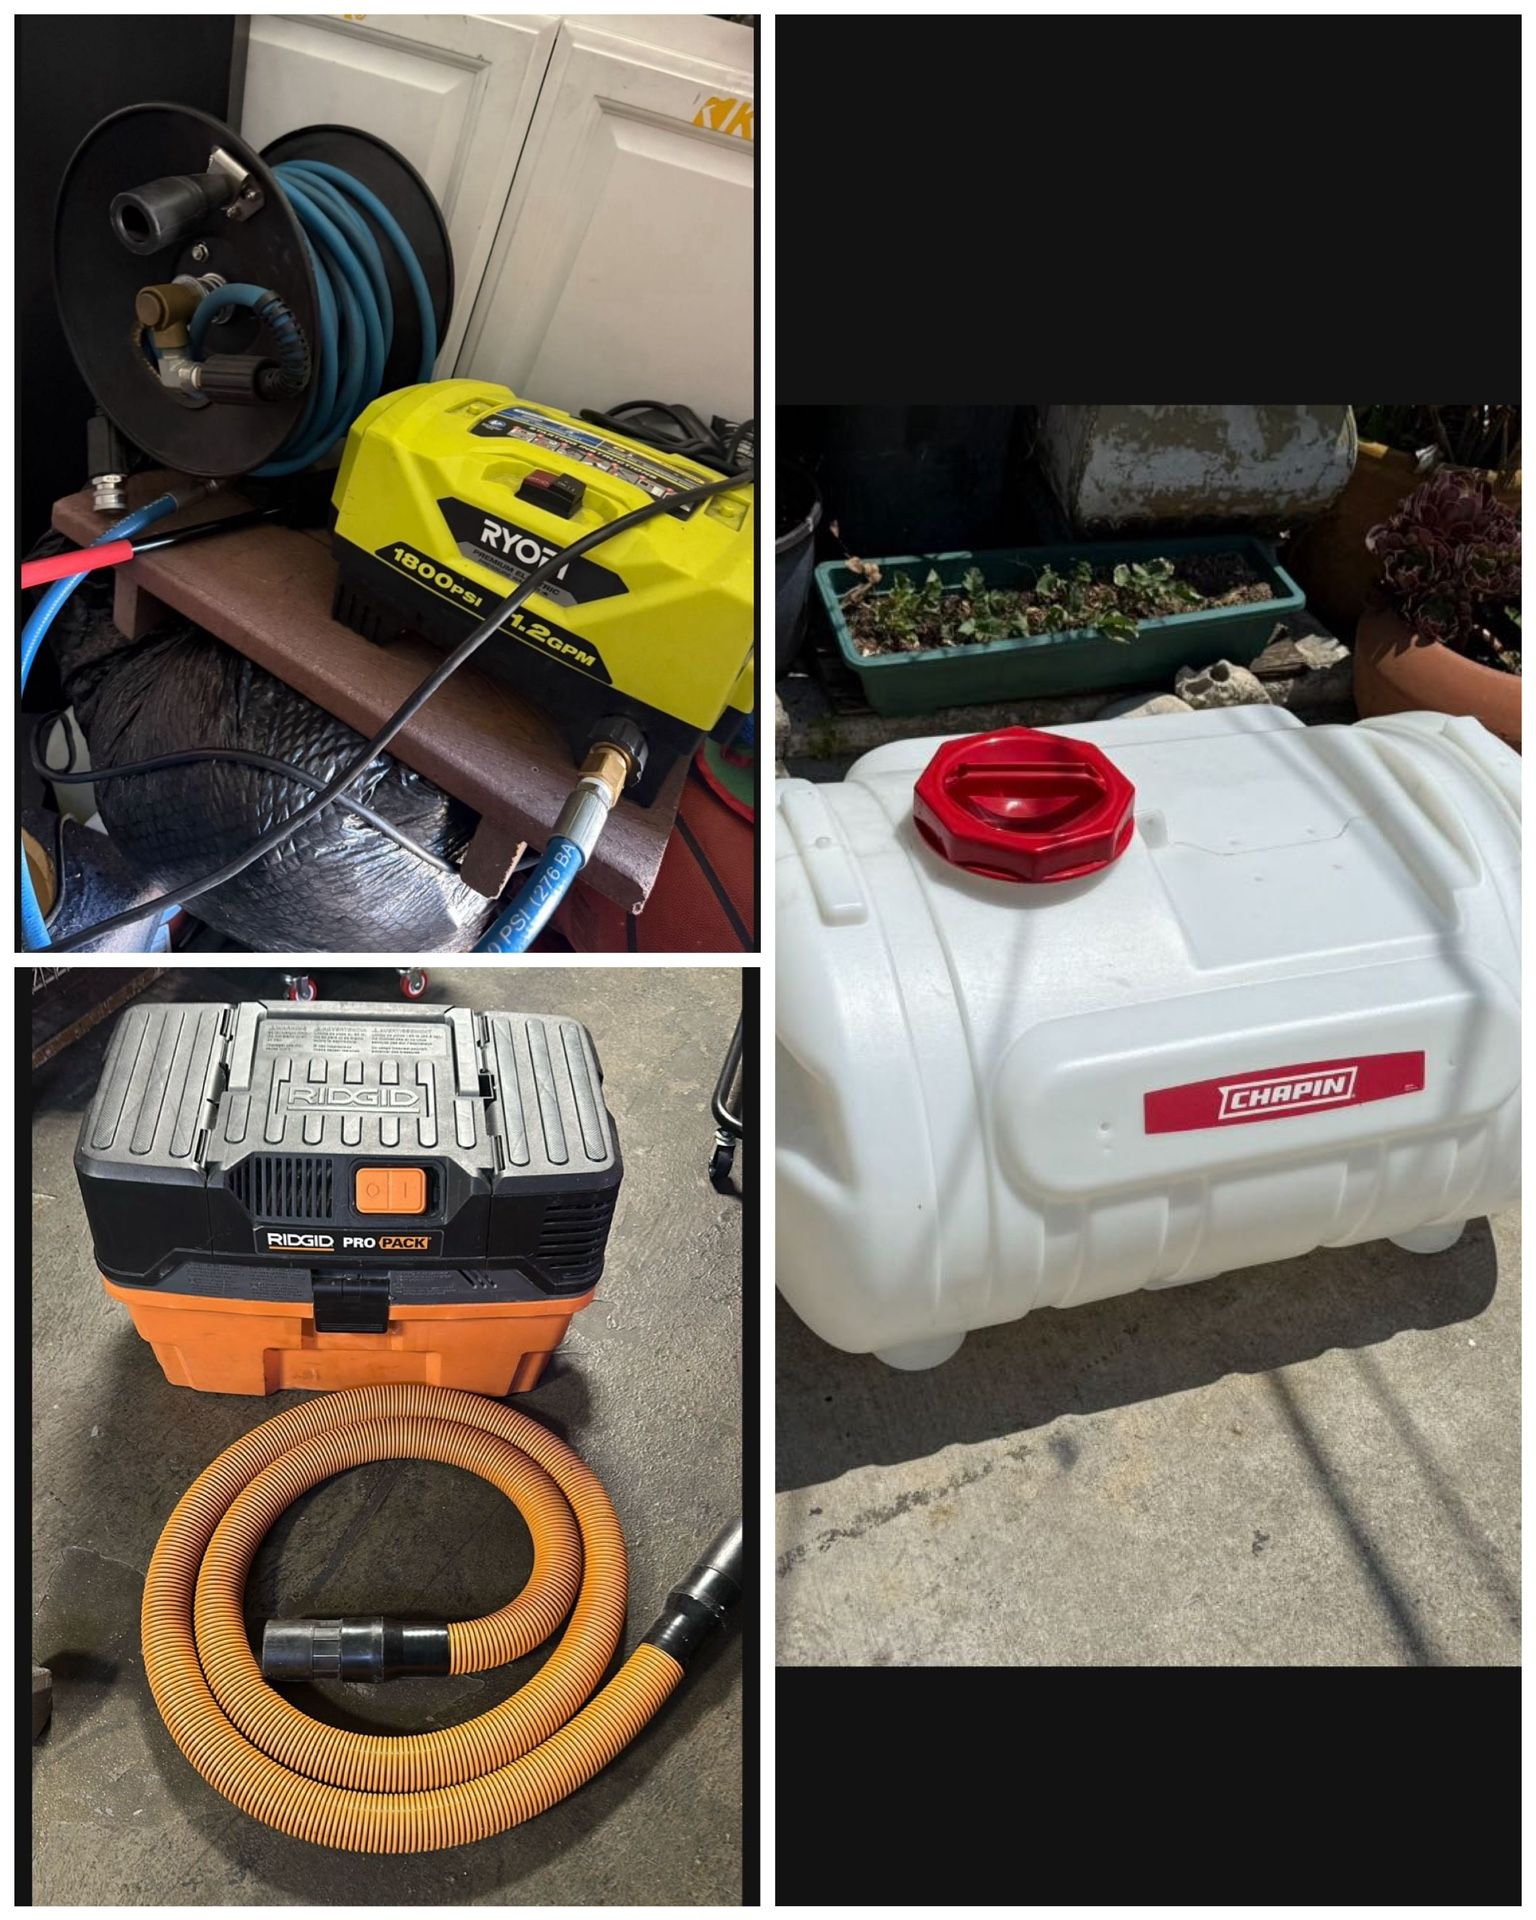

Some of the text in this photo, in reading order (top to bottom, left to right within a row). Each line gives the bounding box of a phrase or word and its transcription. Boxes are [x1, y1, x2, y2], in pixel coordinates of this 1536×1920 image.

[393, 547, 483, 607] 1800PSI
[472, 548, 514, 574] PREMIUM
[514, 567, 560, 596] ELTRIC
[510, 613, 596, 667] 1.2GPM
[500, 908, 531, 944] PSI
[529, 866, 561, 906] (276
[287, 1087, 420, 1107] RIDGID
[1230, 1076, 1346, 1110] CHAPIN
[267, 1233, 425, 1248] RIDGID PRO PACK
